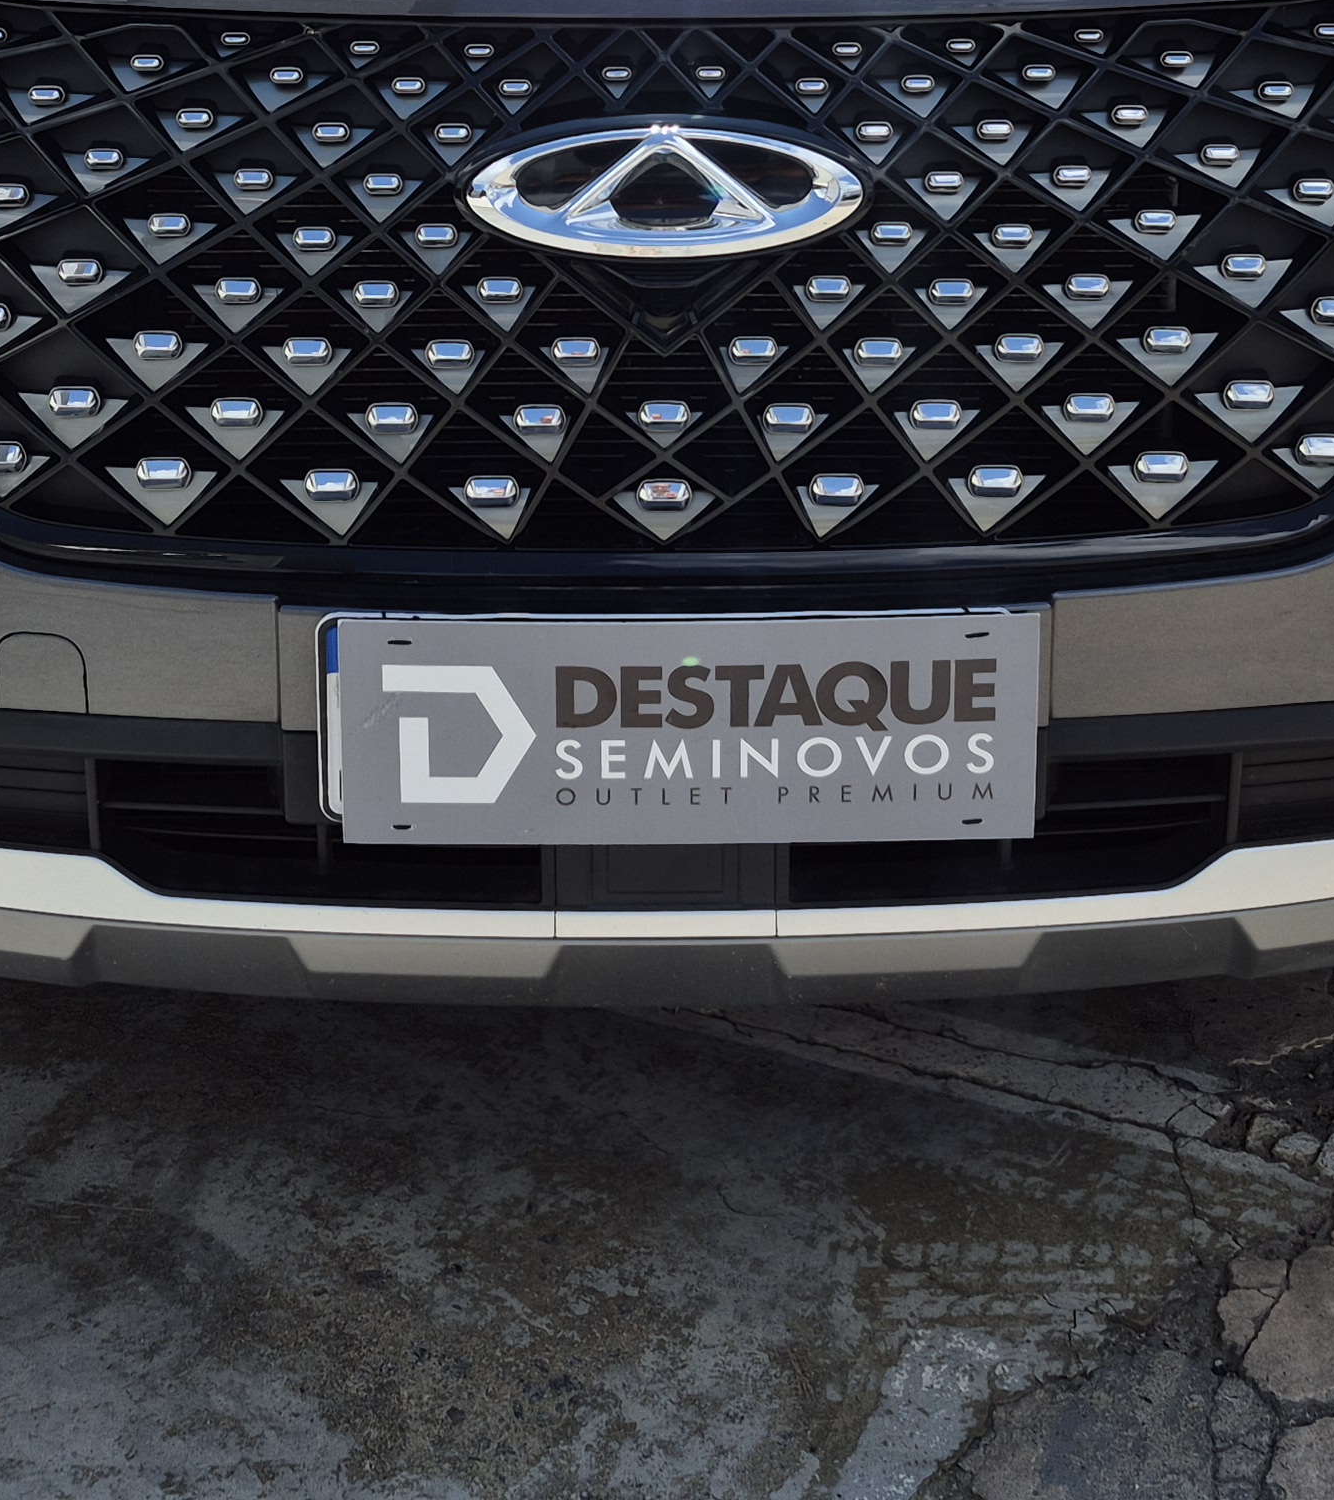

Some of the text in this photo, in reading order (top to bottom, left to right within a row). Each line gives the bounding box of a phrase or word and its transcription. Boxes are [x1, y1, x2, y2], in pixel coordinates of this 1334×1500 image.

[555, 658, 997, 732] DESTAQUE
[554, 732, 995, 781] SEMINOVOS
[555, 782, 995, 806] OUTLET PREMIUM
